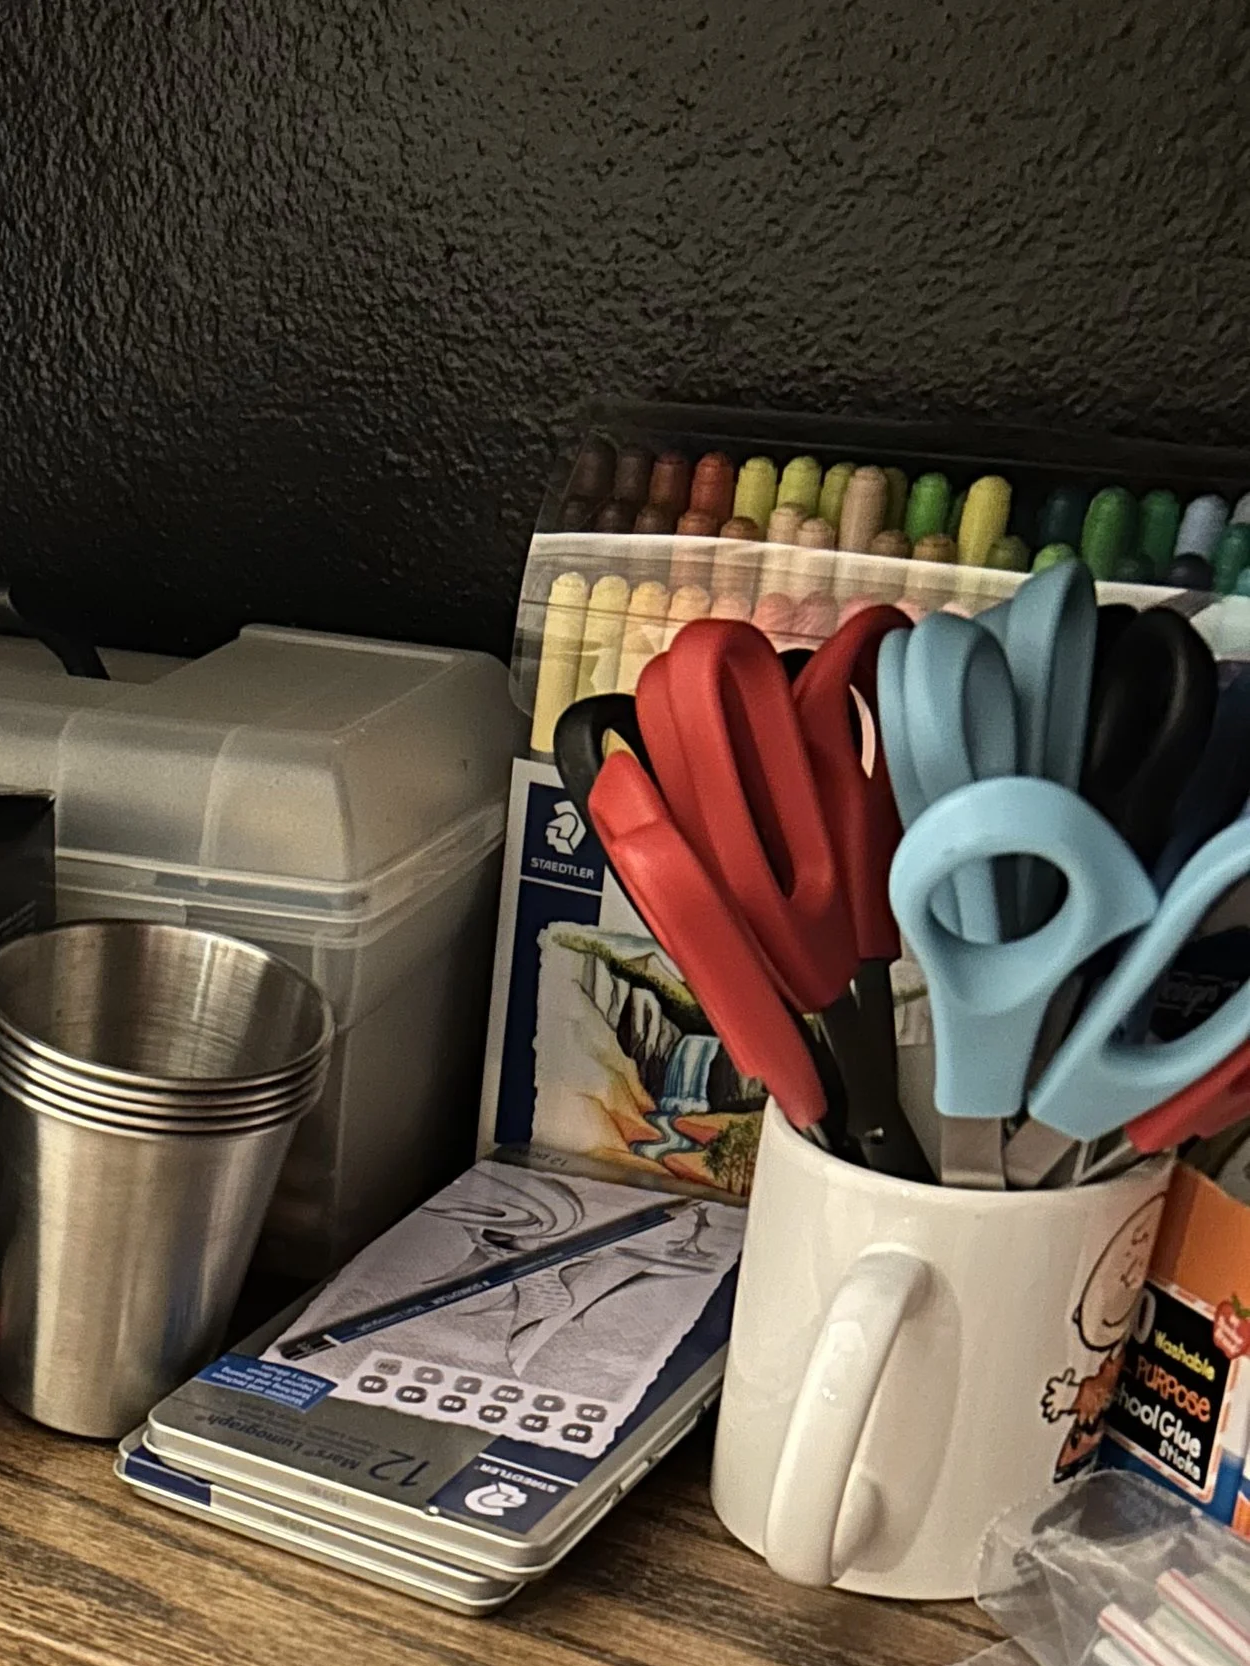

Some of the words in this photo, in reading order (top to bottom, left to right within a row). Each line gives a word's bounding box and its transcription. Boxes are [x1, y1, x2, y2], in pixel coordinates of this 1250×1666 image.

[530, 857, 595, 880] STAEDTLER
[1154, 1328, 1216, 1383] Washable
[1136, 1354, 1212, 1423] PURPOSE
[1158, 1410, 1202, 1460] Glue
[369, 1449, 431, 1487] 12
[1158, 1439, 1201, 1482] Sticks
